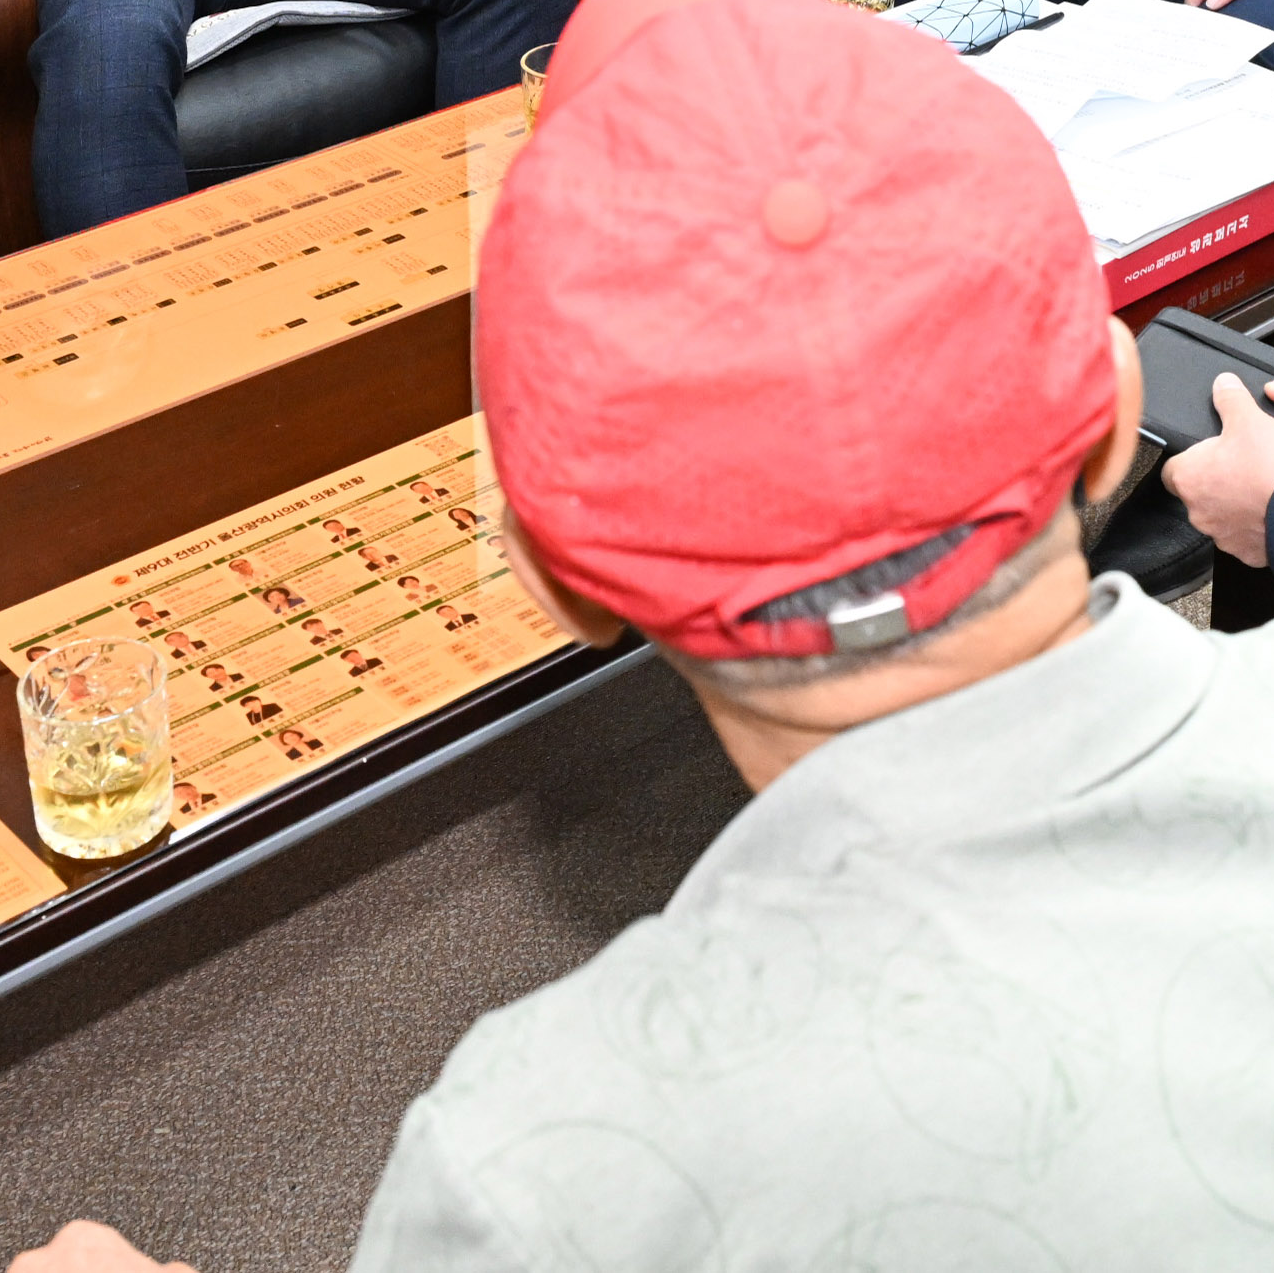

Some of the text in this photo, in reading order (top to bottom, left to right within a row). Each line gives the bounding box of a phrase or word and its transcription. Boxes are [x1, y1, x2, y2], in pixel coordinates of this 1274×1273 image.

[132, 475, 366, 580] 제9대 전반기 울산광역시의회 의원 현황
